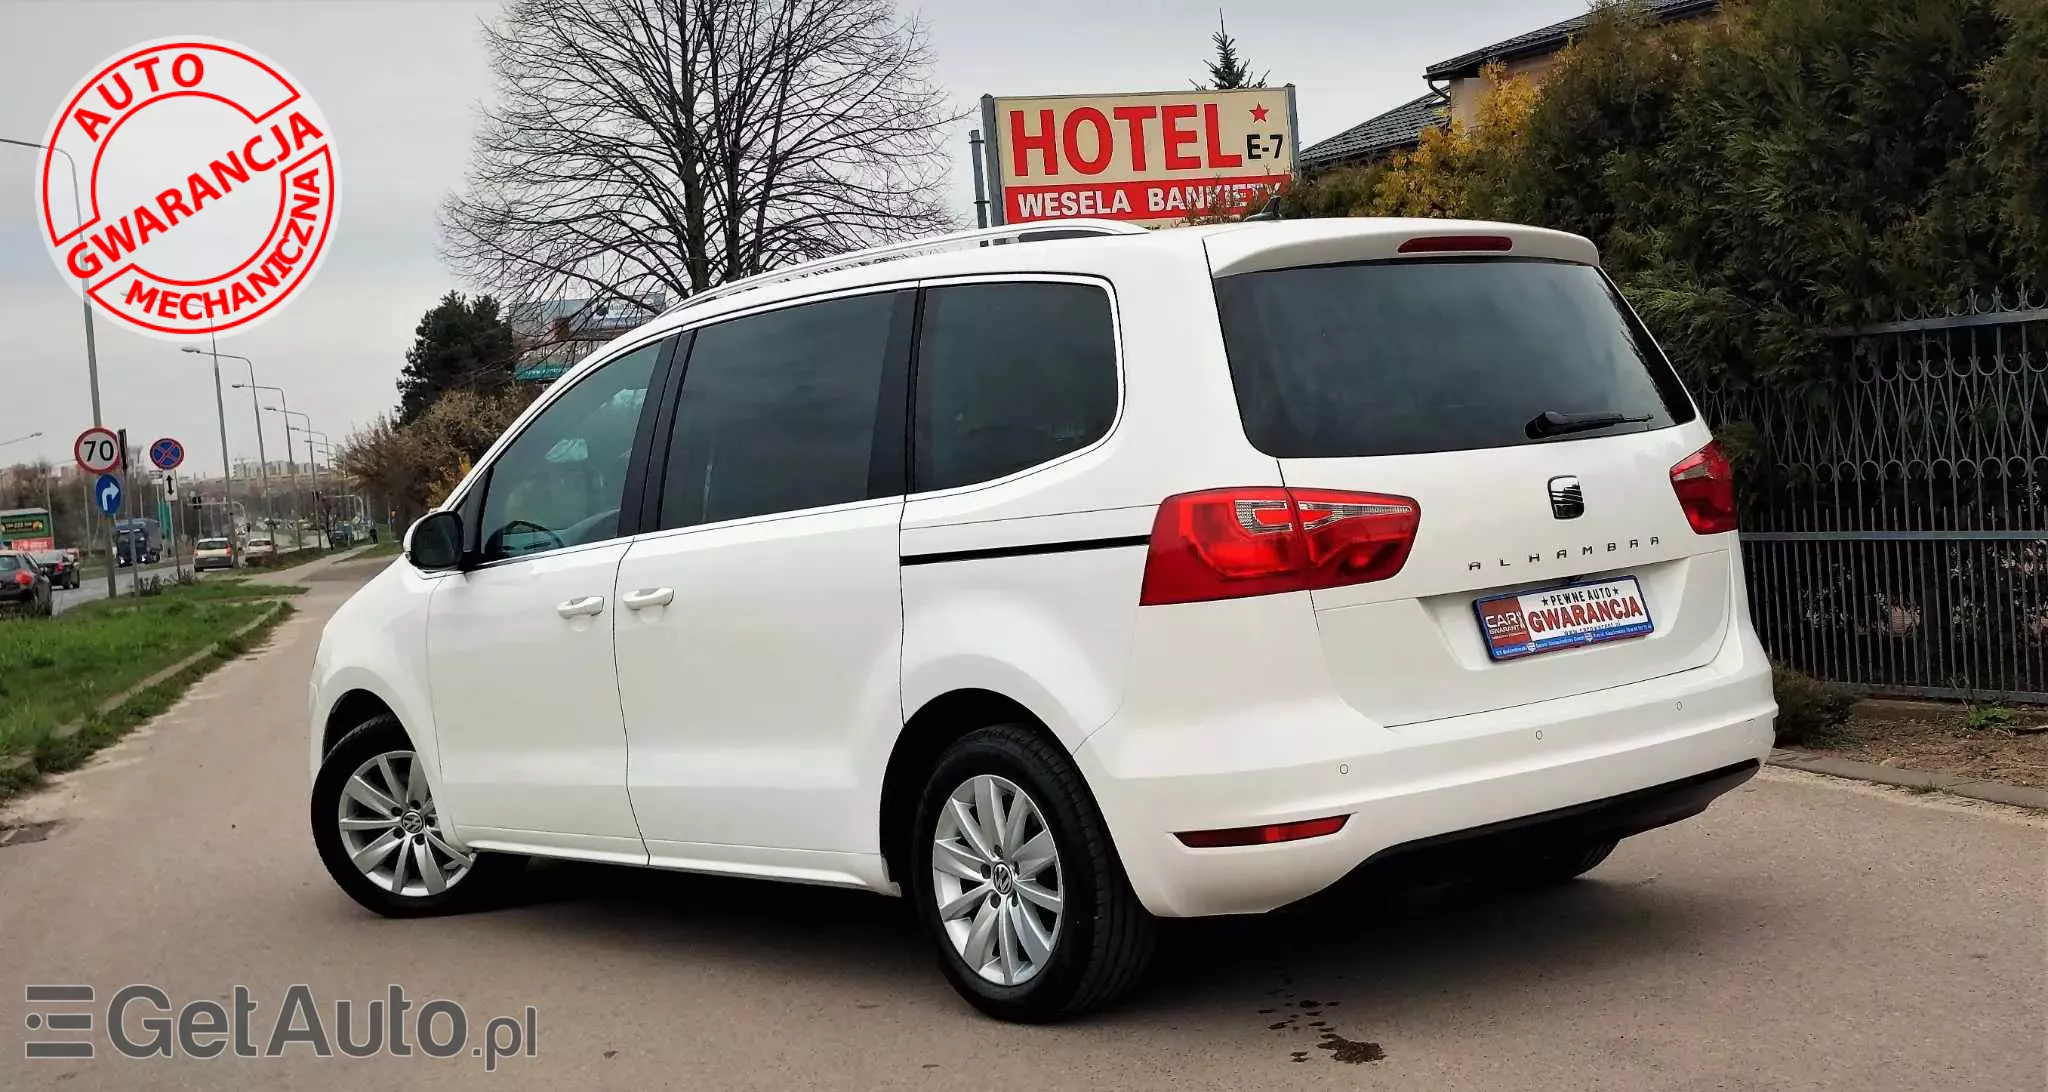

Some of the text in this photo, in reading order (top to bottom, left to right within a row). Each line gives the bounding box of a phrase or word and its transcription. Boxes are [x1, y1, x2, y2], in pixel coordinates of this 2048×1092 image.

[1009, 103, 1284, 177] HOTEL E-7
[1017, 189, 1132, 218] WESELA
[83, 440, 115, 462] 70
[1468, 536, 1660, 571] ALHAMBRA
[1550, 586, 1612, 607] PEWNE AUTO
[1485, 612, 1518, 628] CAR
[1528, 595, 1644, 633] GWARANCJA
